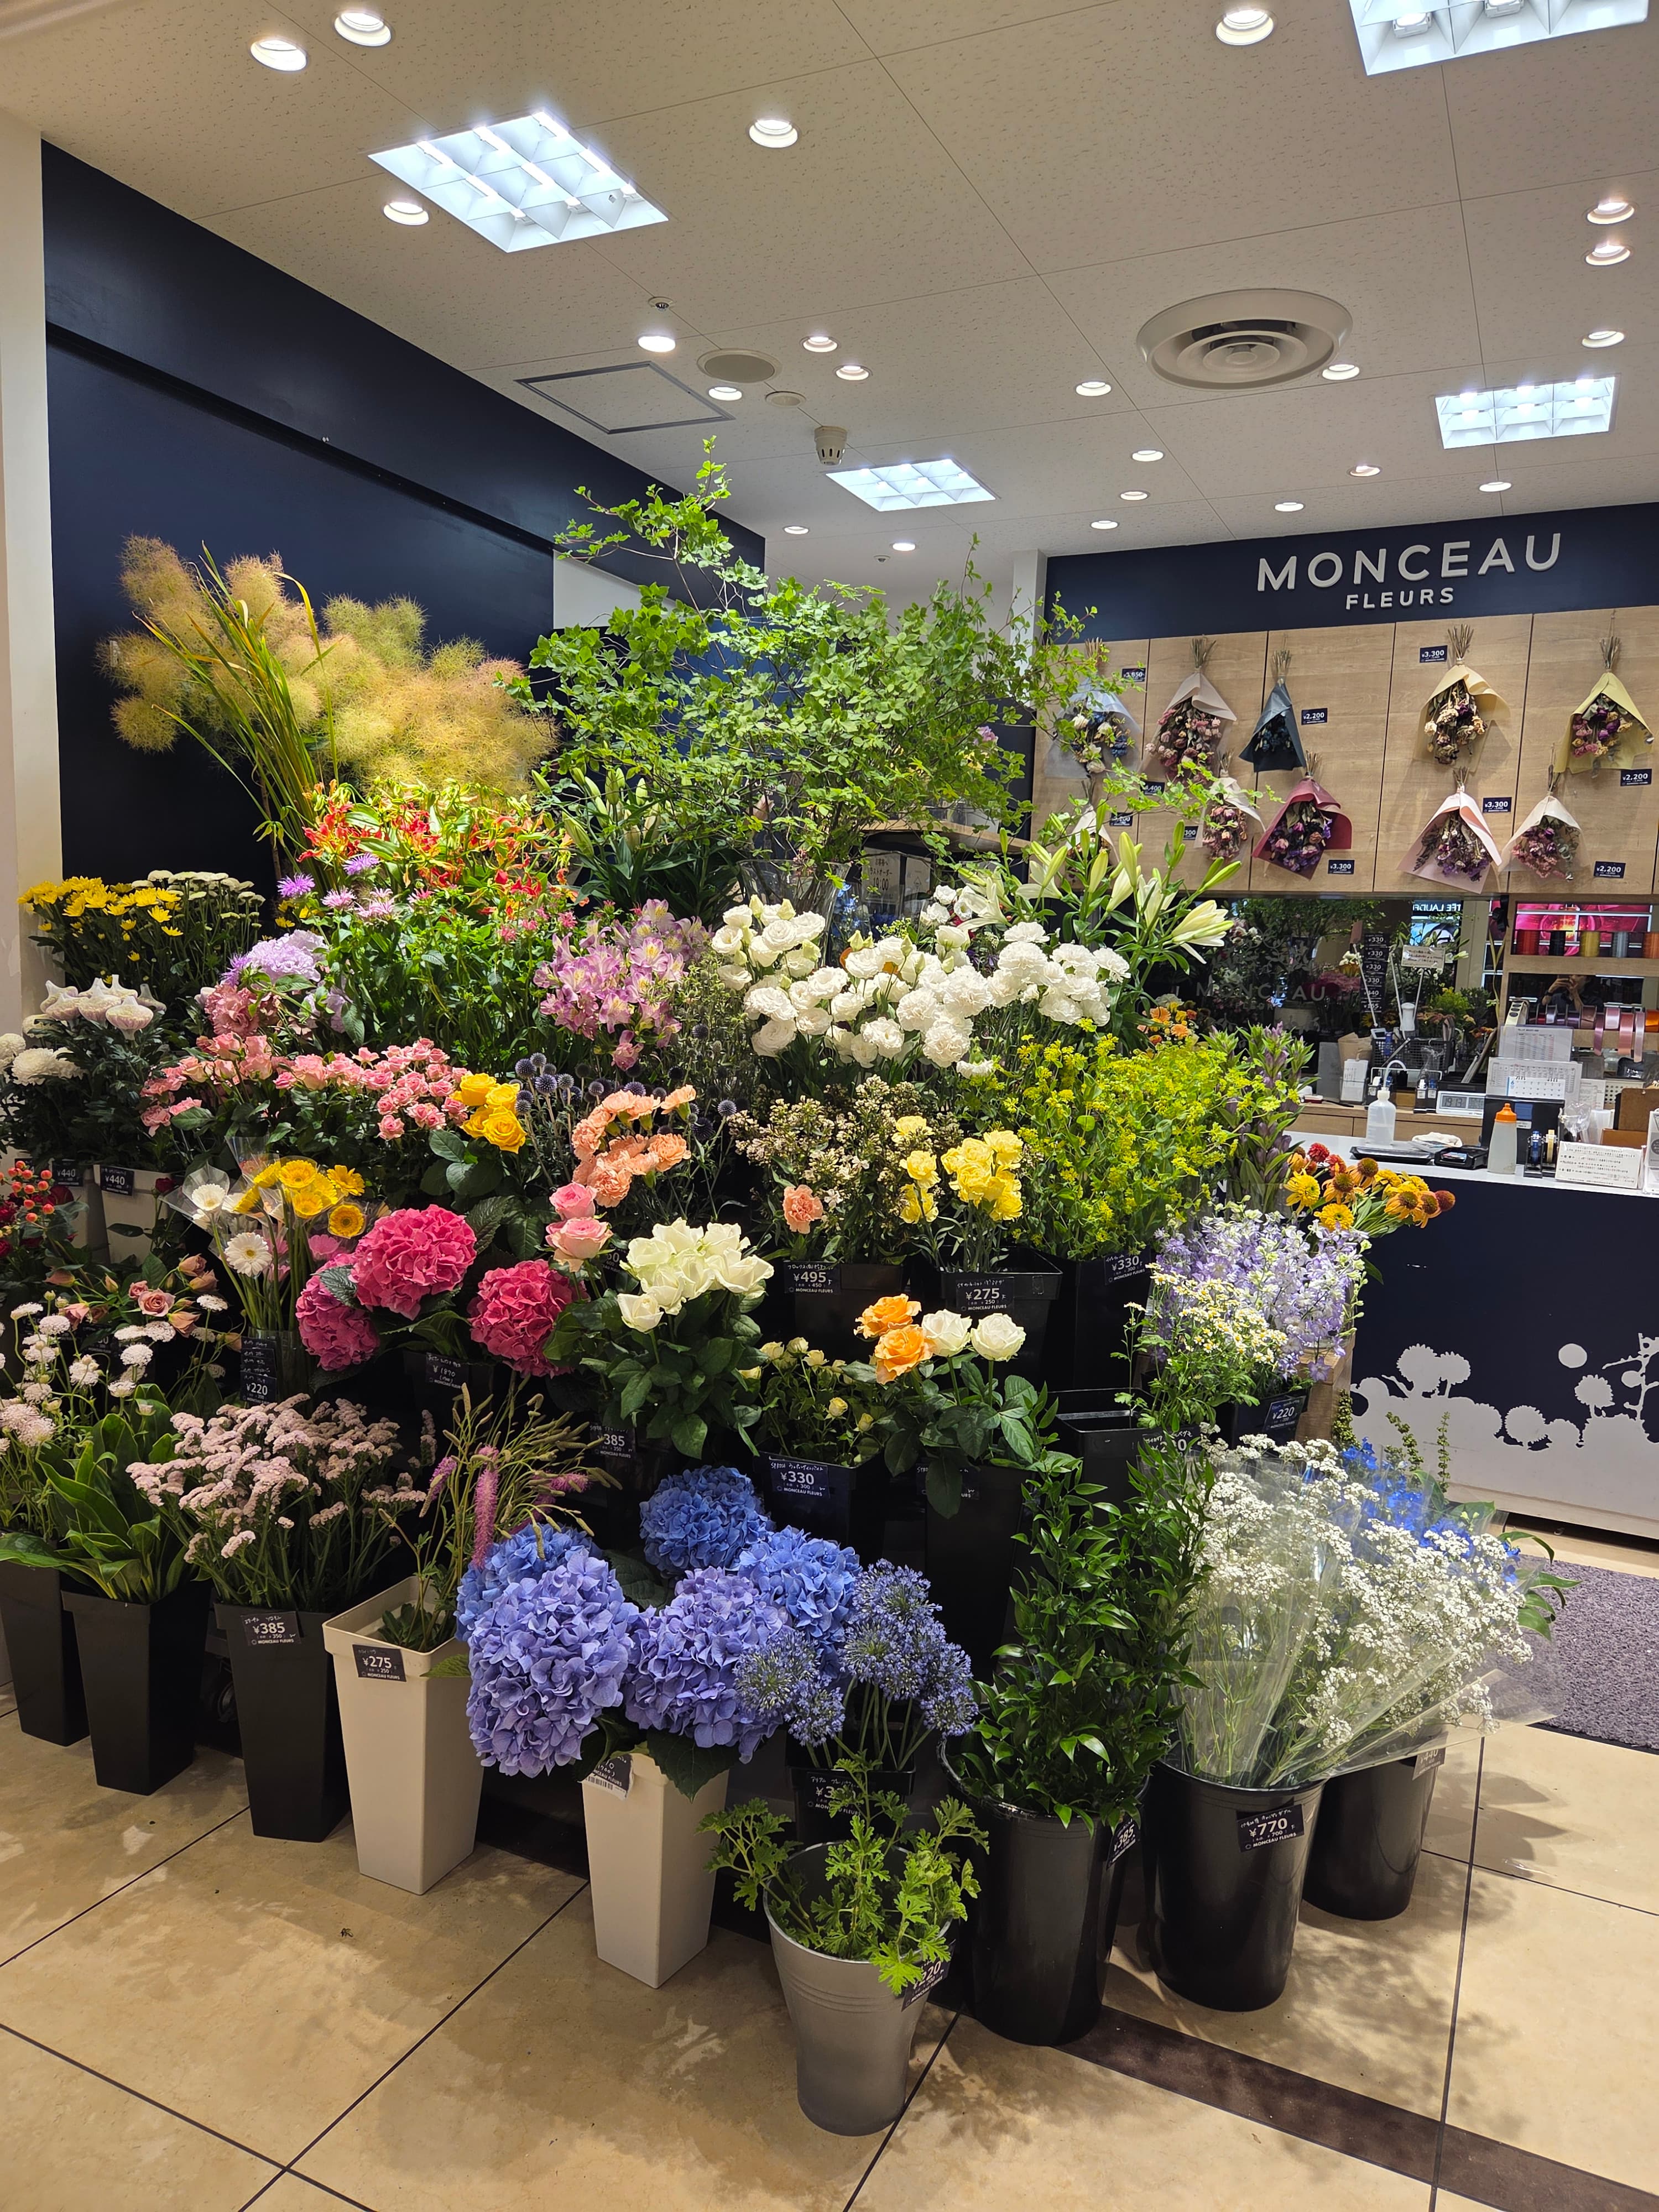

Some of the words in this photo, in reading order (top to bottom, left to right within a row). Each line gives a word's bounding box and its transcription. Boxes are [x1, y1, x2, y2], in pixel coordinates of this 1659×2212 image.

[1257, 533, 1561, 592] MONCEAU
[1345, 587, 1454, 611] FLEURS
[58, 1168, 76, 1177] ¥440
[105, 1174, 126, 1186] ¥440
[1112, 1255, 1140, 1271] ¥330
[793, 1271, 827, 1283] ¥495
[965, 1287, 1000, 1300] ¥275
[246, 1382, 268, 1396] ¥220
[1272, 1406, 1295, 1420] ¥220
[780, 1470, 815, 1485] ¥330
[252, 1622, 285, 1634] ¥385
[362, 1655, 392, 1669] ¥275
[815, 1803, 843, 1812] MONU
[1249, 1818, 1288, 1838] ¥770
[1114, 1824, 1135, 1851] ¥385
[1253, 1837, 1279, 1847] MONCEAU
[1279, 1832, 1297, 1840] FLEURS
